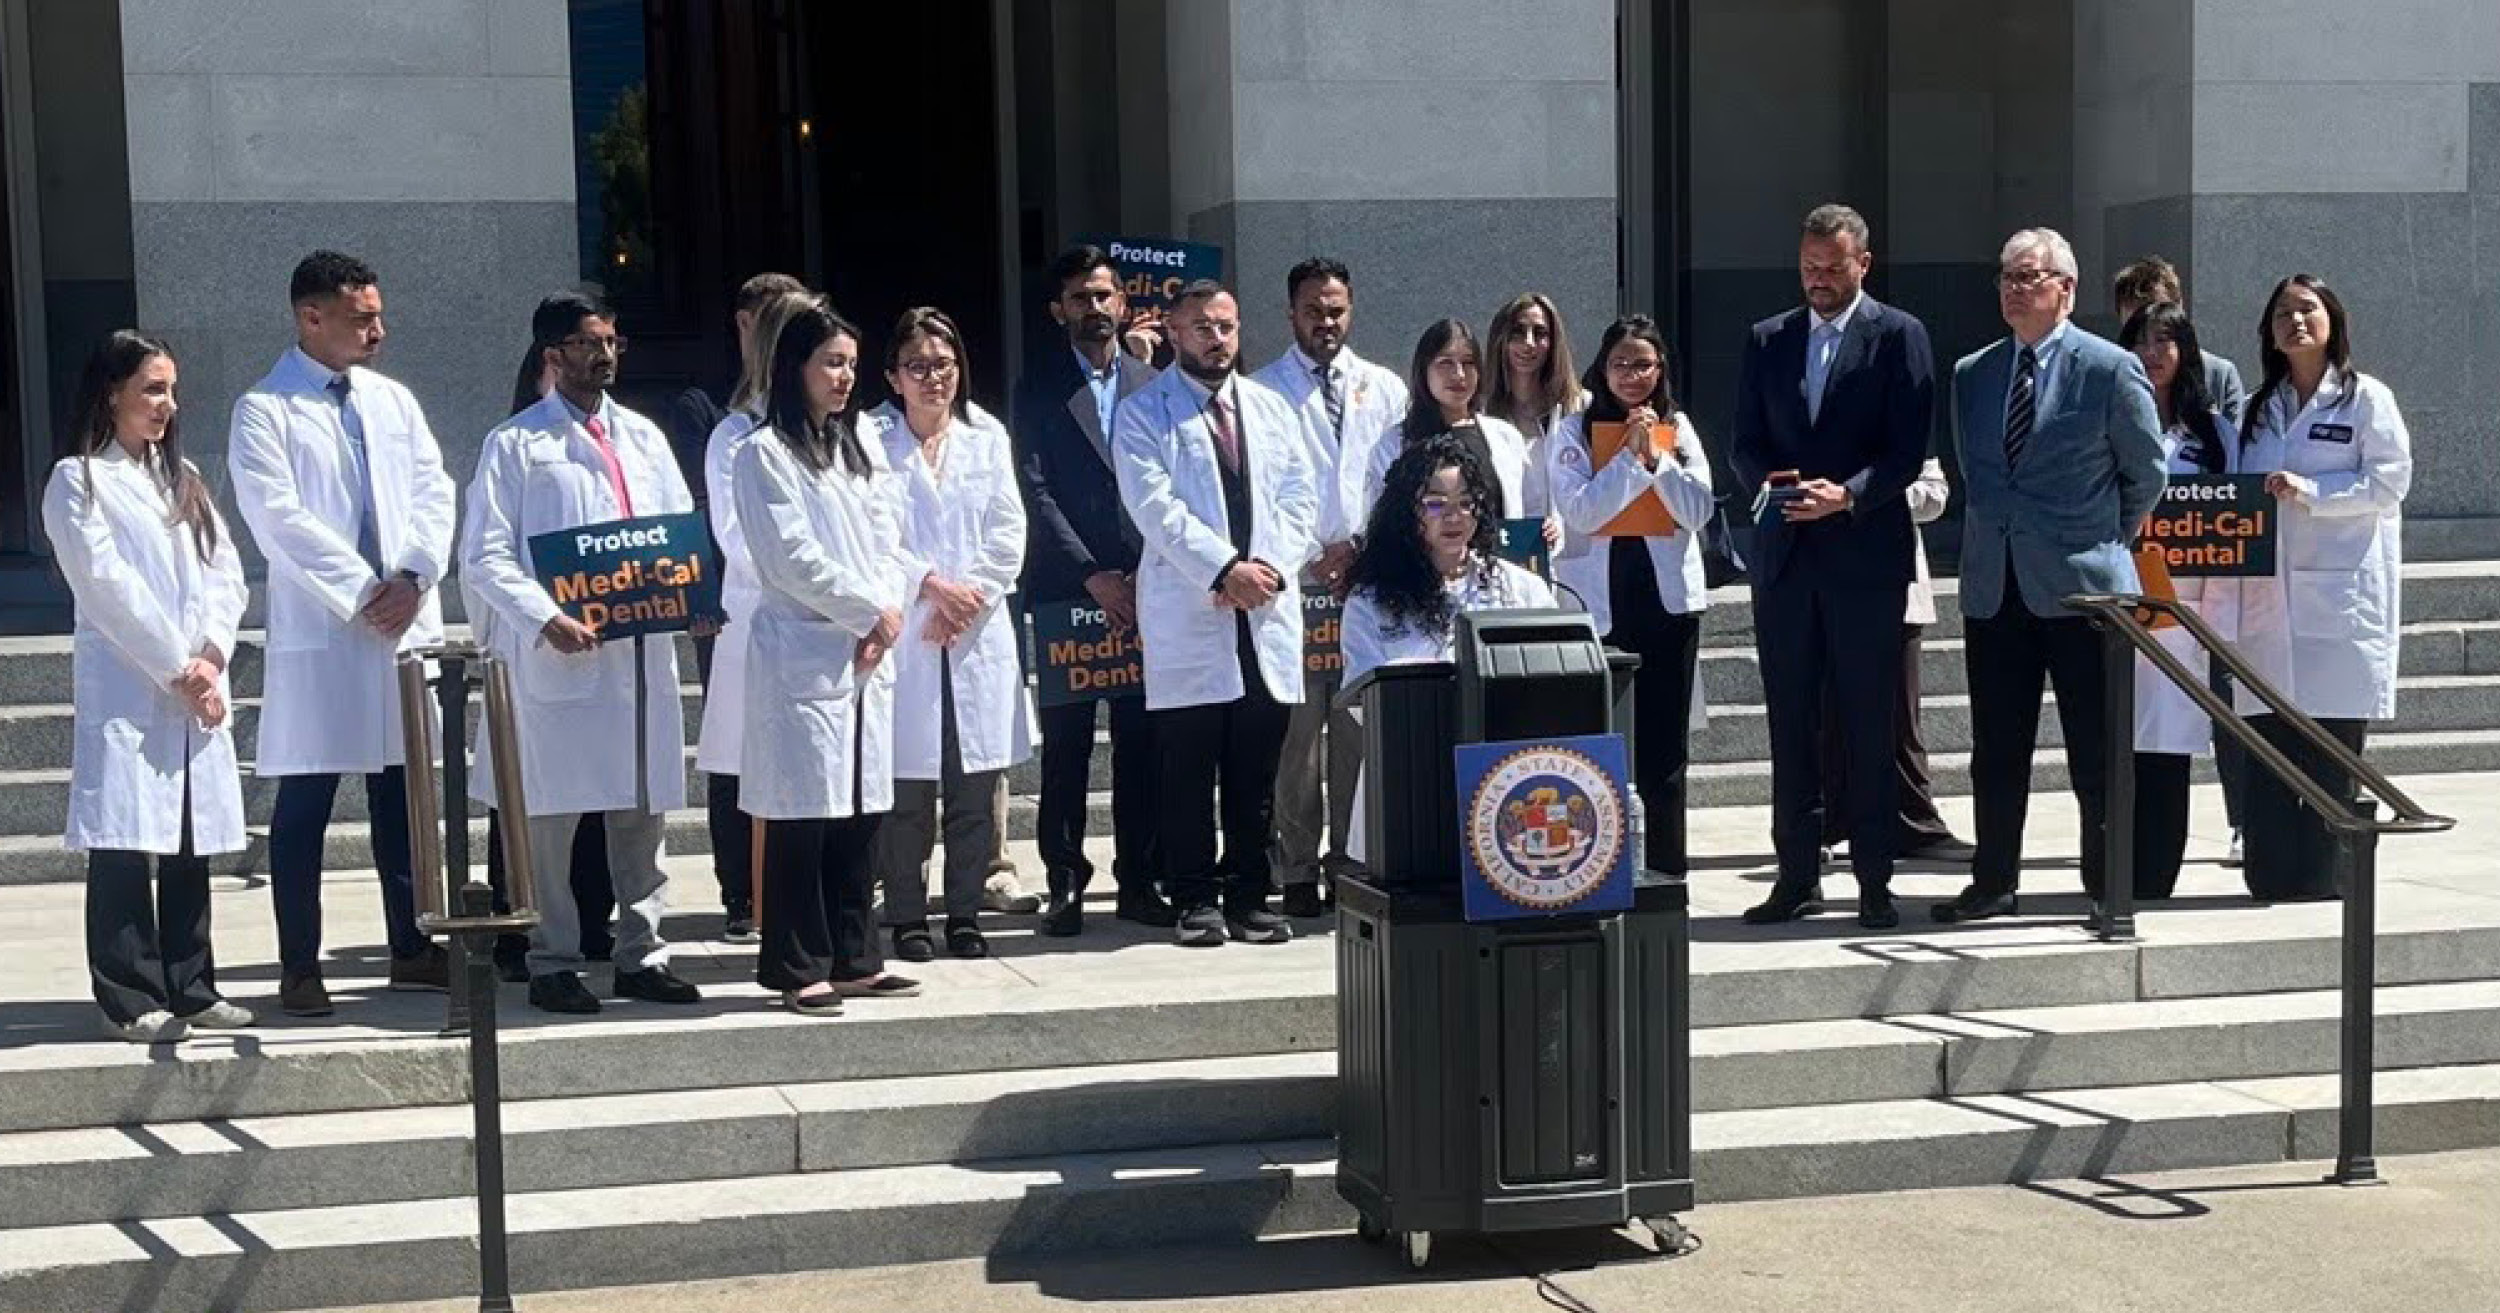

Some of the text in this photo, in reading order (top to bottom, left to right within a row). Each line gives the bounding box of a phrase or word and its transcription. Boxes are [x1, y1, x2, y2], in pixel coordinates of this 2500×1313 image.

[1110, 242, 1186, 267] Protect
[2166, 483, 2238, 501] rotect
[575, 524, 668, 556] Protect
[553, 553, 701, 604] Medi-Cal
[581, 588, 687, 632] Dental
[1069, 662, 1141, 691] Dent
